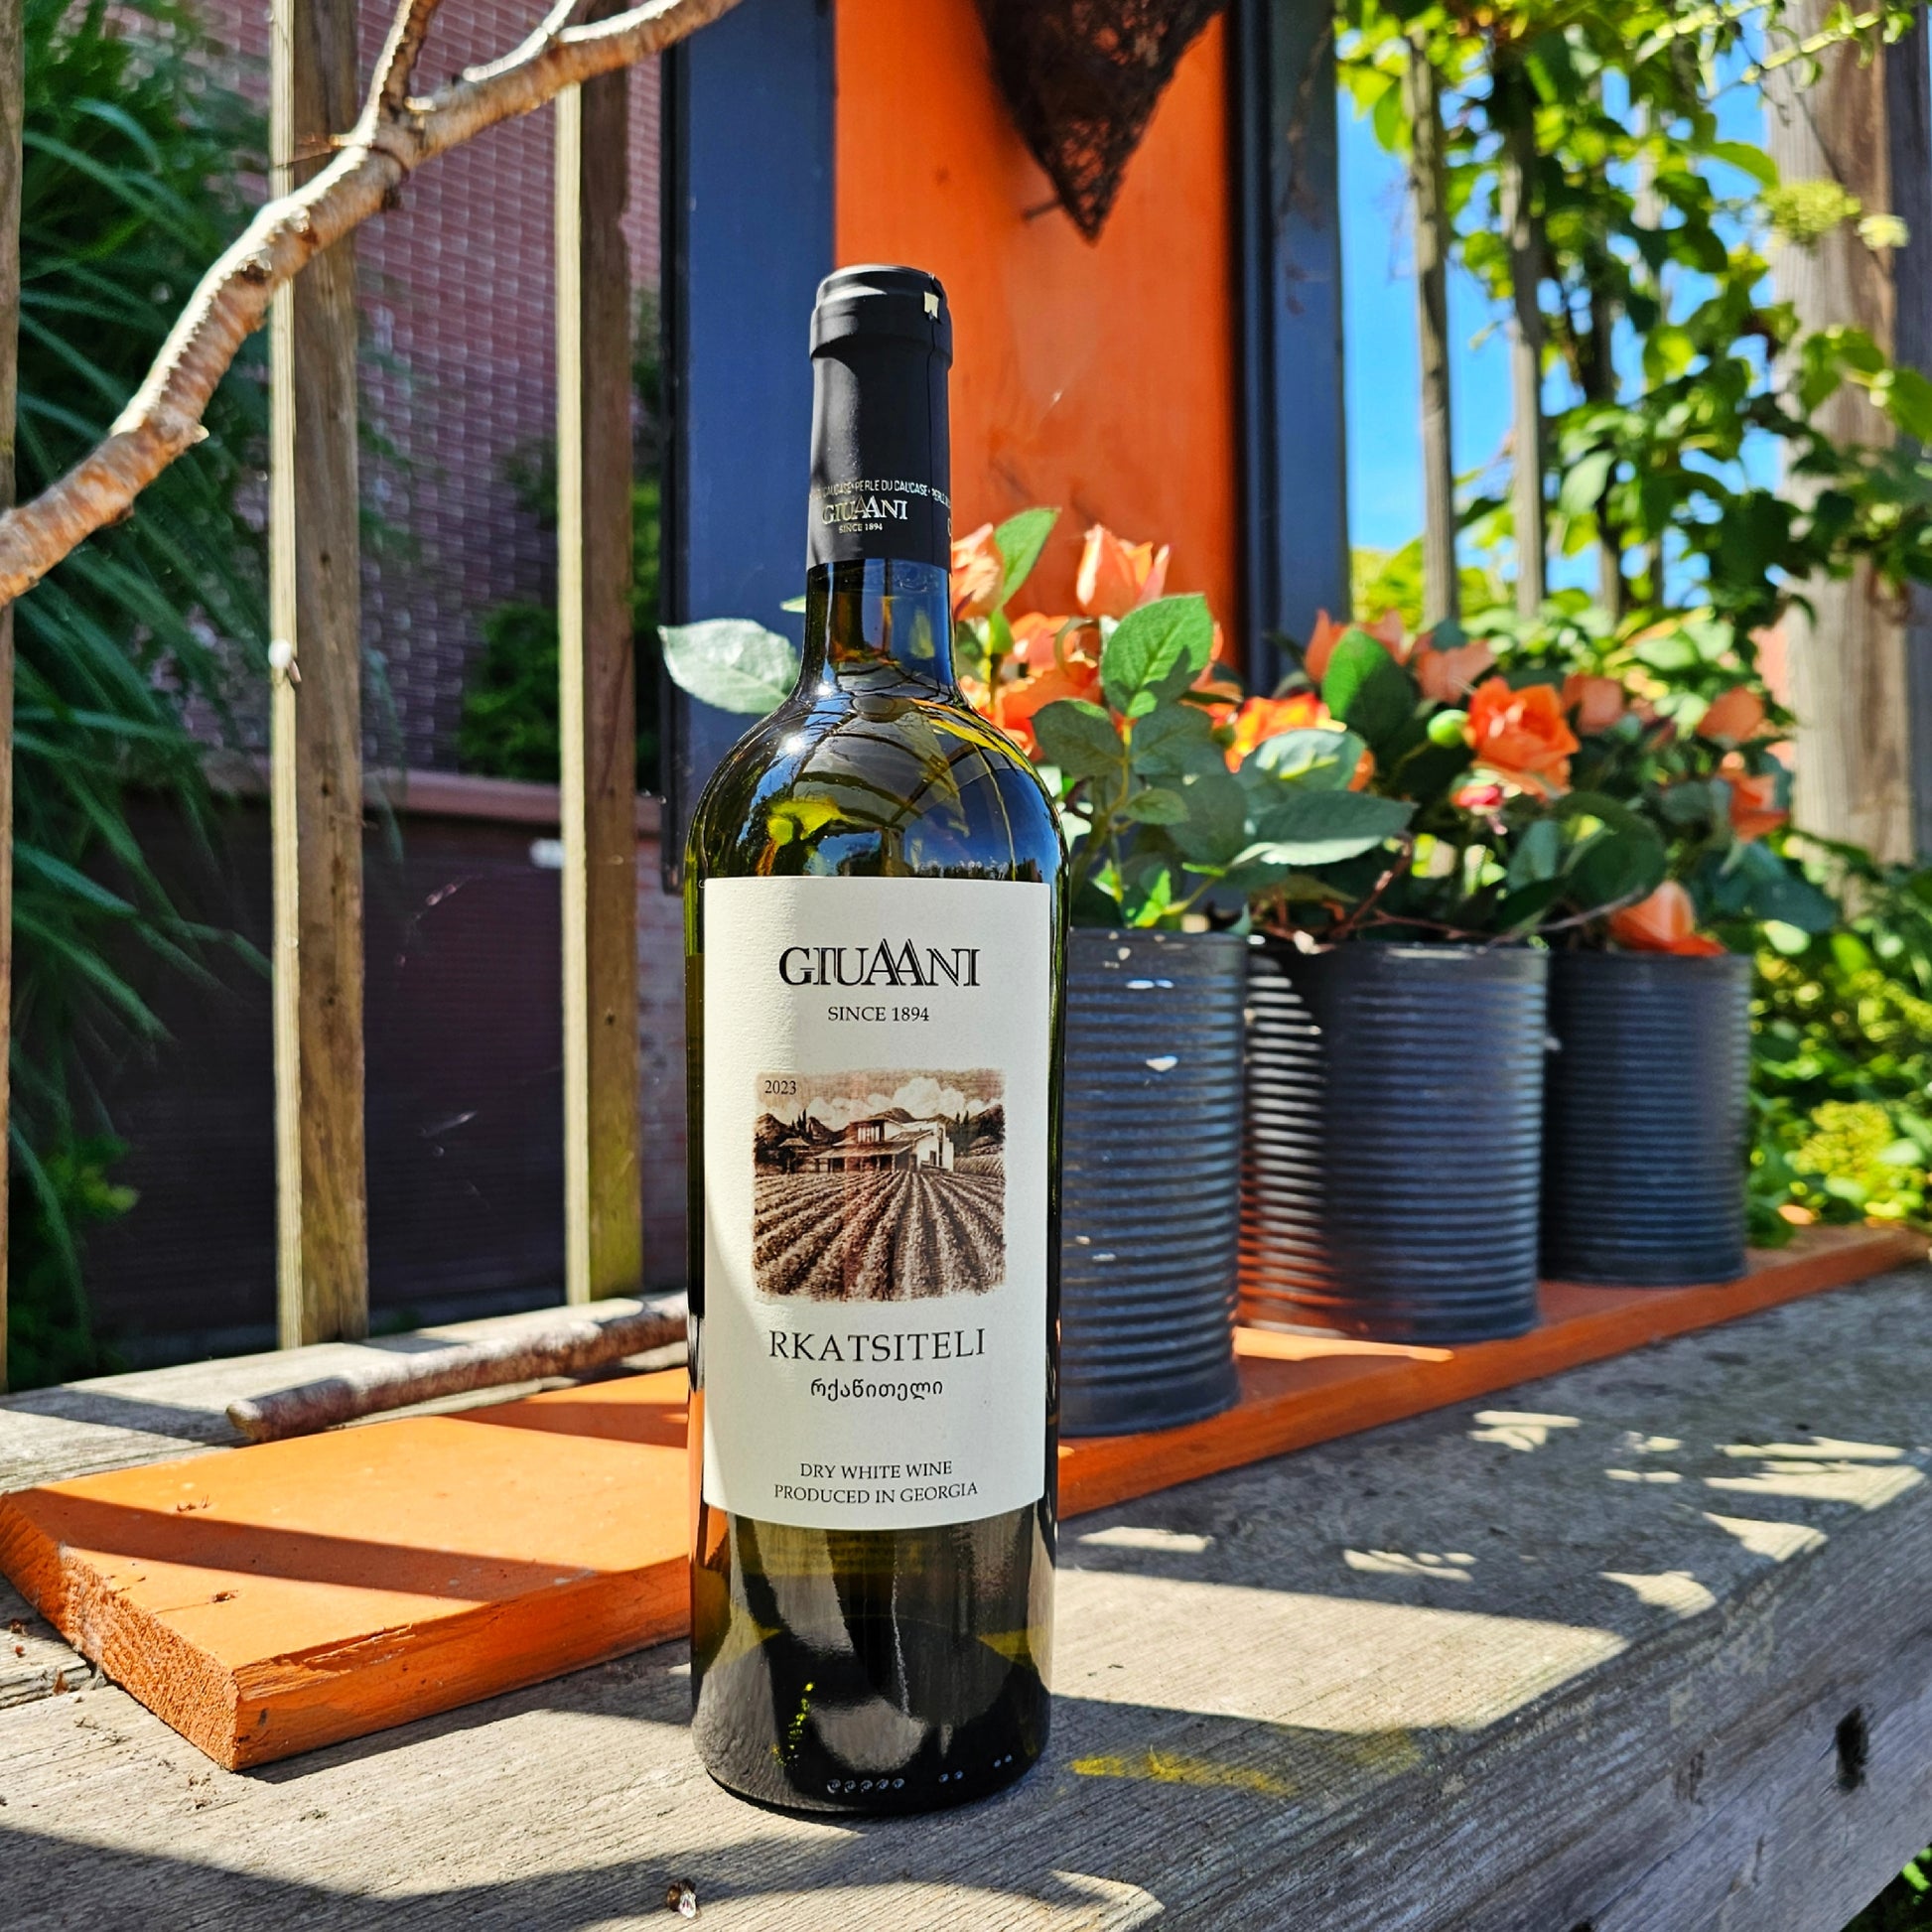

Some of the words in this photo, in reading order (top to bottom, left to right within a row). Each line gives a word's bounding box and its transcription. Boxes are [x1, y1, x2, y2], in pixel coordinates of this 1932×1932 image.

[855, 480, 880, 492] PERLE
[881, 480, 894, 491] DU
[894, 480, 928, 495] CAUCASE
[821, 495, 908, 525] GIUAANI
[838, 522, 863, 534] SINCE
[864, 522, 884, 532] 1894
[779, 938, 980, 987] GIUAANI
[828, 1007, 886, 1022] SINCE
[892, 1007, 929, 1022] 1894
[764, 1079, 797, 1095] 2023
[769, 1328, 985, 1362] RKATSITELI
[811, 1378, 942, 1402] რქაწითელი
[801, 1463, 836, 1478] DRY
[841, 1465, 900, 1479] WHITE
[906, 1460, 952, 1477] WINE
[775, 1484, 870, 1503] PRODUCED
[876, 1490, 895, 1503] IN
[899, 1481, 978, 1502] GEORGIA
